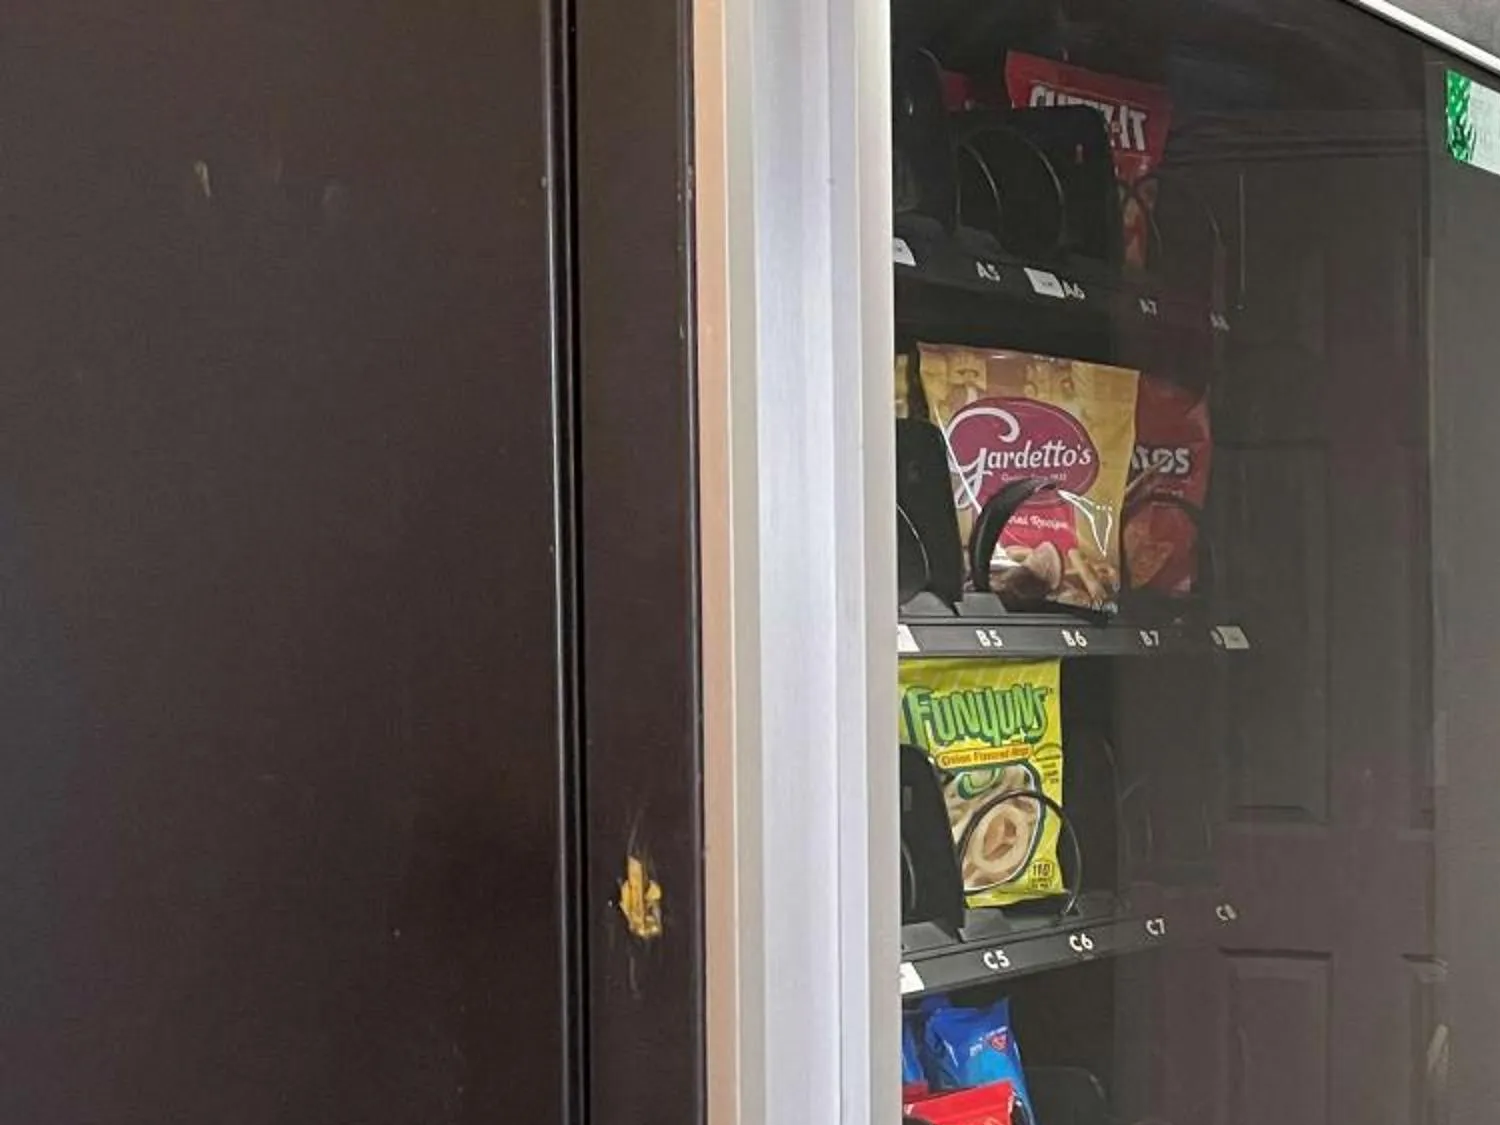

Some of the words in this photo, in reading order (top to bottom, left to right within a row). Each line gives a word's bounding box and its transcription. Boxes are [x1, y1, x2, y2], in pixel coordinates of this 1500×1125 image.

[946, 407, 1092, 509] Gardetto's
[975, 629, 1003, 648] B5
[1062, 628, 1088, 648] B6
[1139, 629, 1160, 647] B7
[1215, 903, 1237, 921] C8
[1145, 917, 1167, 936] C7
[1069, 932, 1094, 951] C6
[983, 949, 1011, 970] C5
